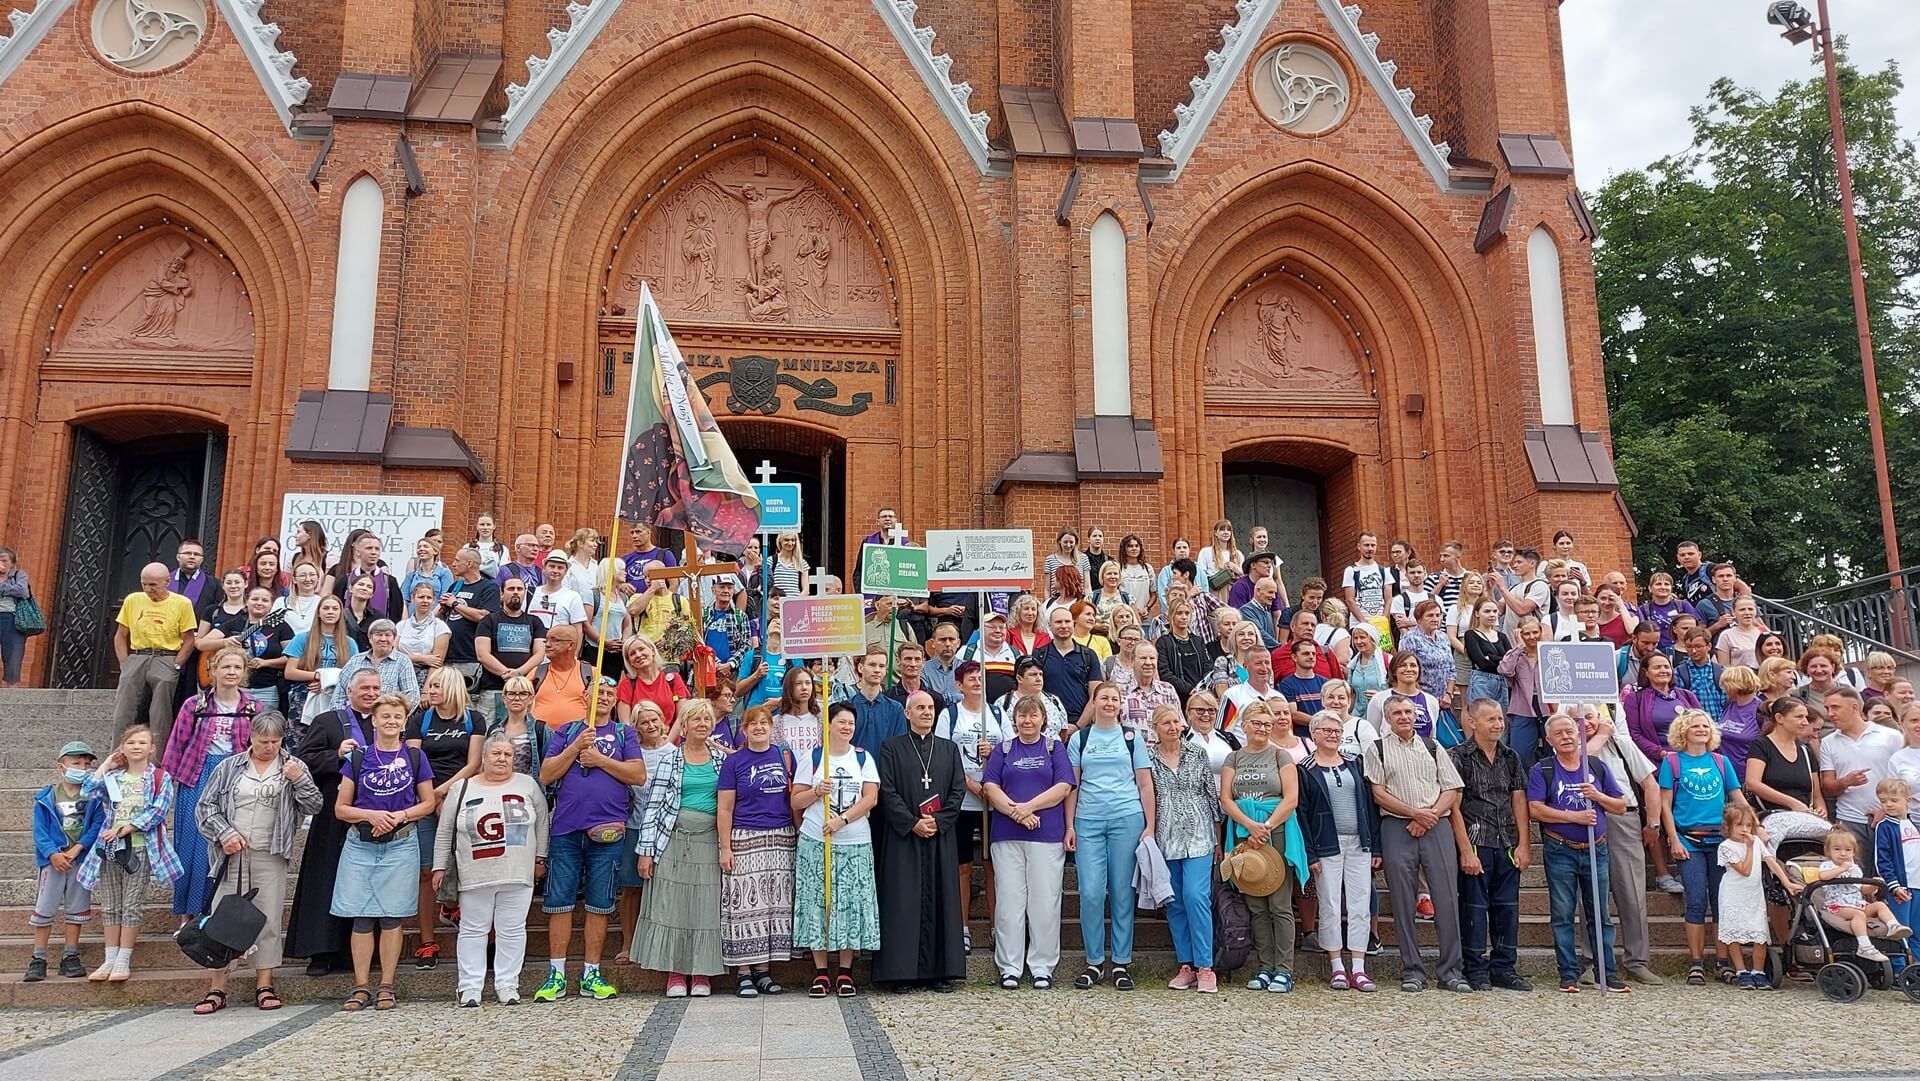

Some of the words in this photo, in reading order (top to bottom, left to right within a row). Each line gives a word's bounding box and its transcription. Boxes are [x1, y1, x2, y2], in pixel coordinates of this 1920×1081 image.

[783, 358, 880, 373] MNIEJSZA
[289, 499, 436, 518] KATEDRALNE
[288, 517, 408, 535] KNCERTY
[965, 543, 997, 551] PIESZA
[898, 562, 916, 570] GRUPA
[1575, 662, 1596, 670] GRUPA
[1575, 671, 1610, 679] FIOLETOWA
[1237, 773, 1267, 781] ROOF
